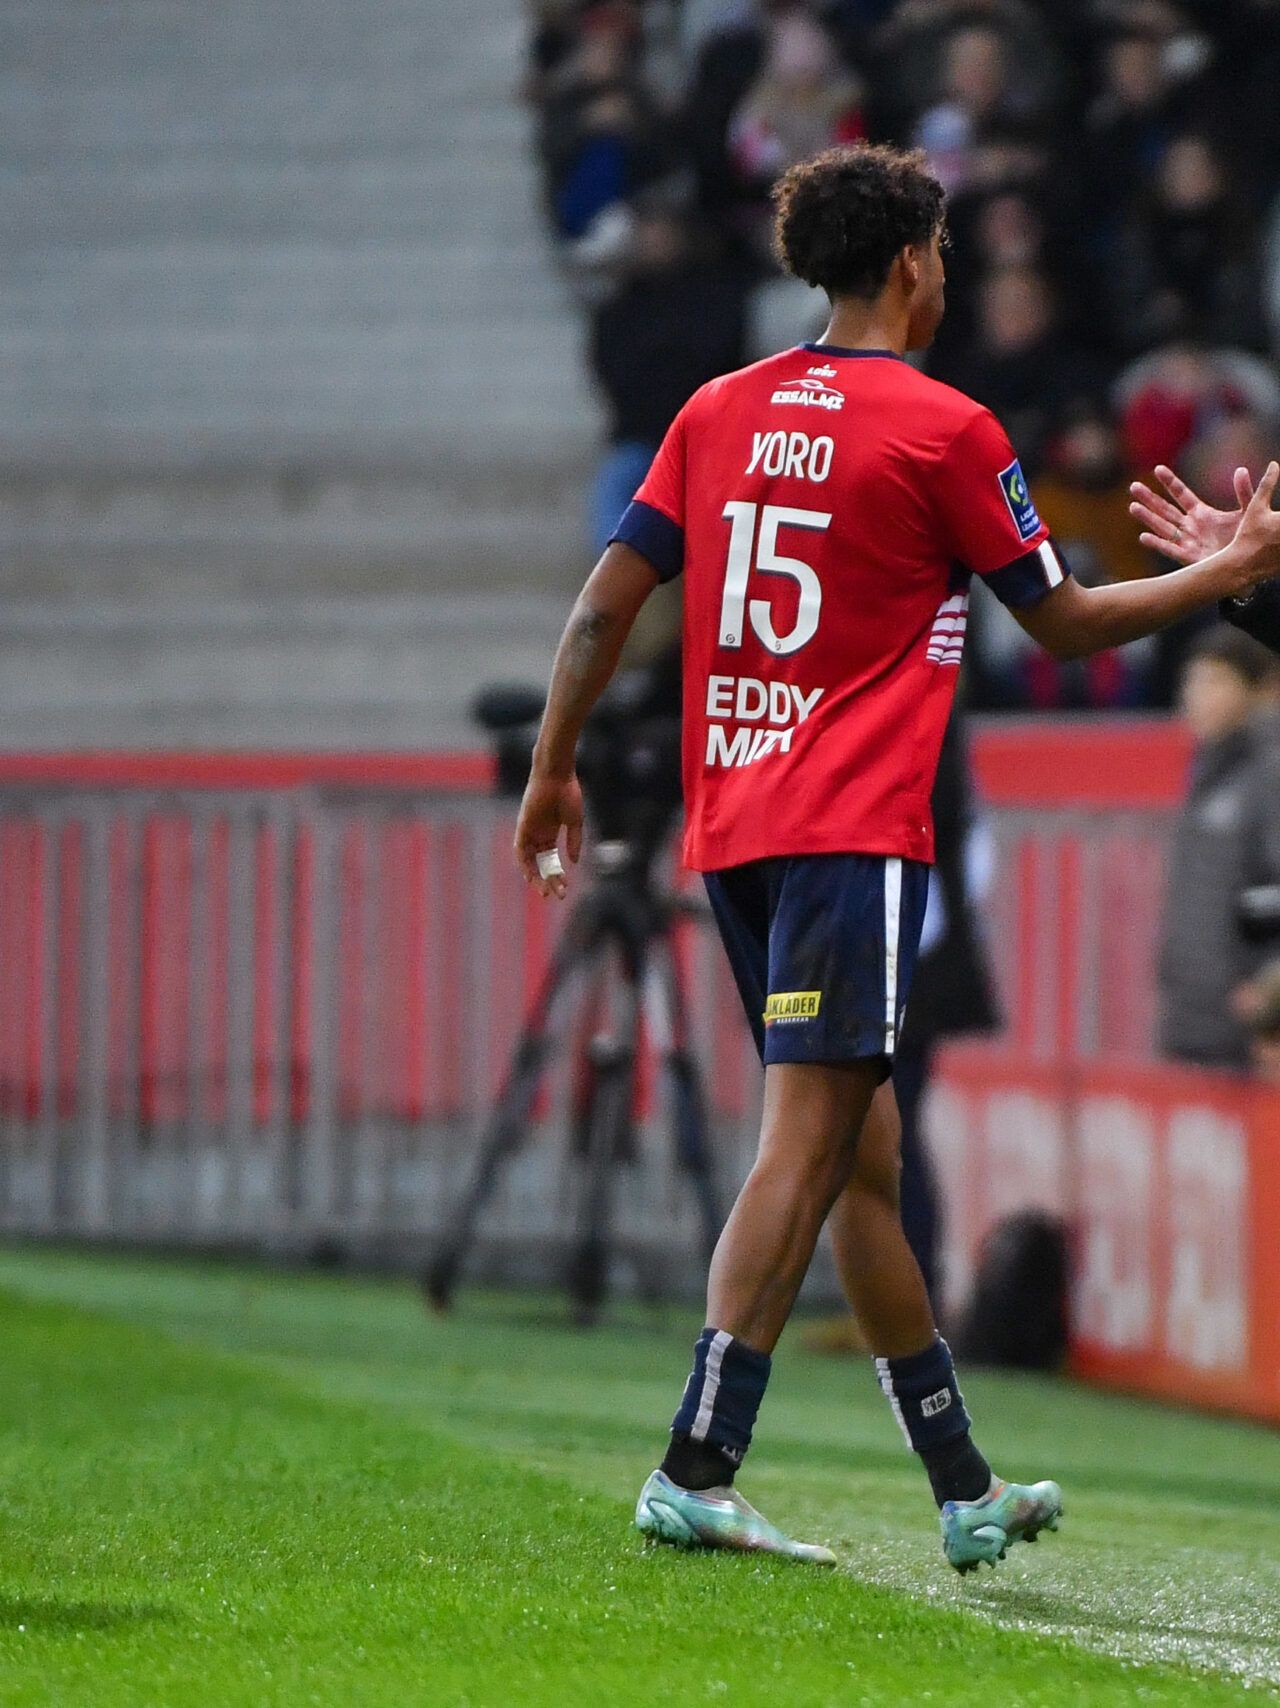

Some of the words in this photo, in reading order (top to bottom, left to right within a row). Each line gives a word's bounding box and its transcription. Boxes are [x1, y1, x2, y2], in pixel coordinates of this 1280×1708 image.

[744, 430, 835, 483] YORO
[718, 500, 833, 655] 15
[705, 674, 825, 724] EDDY
